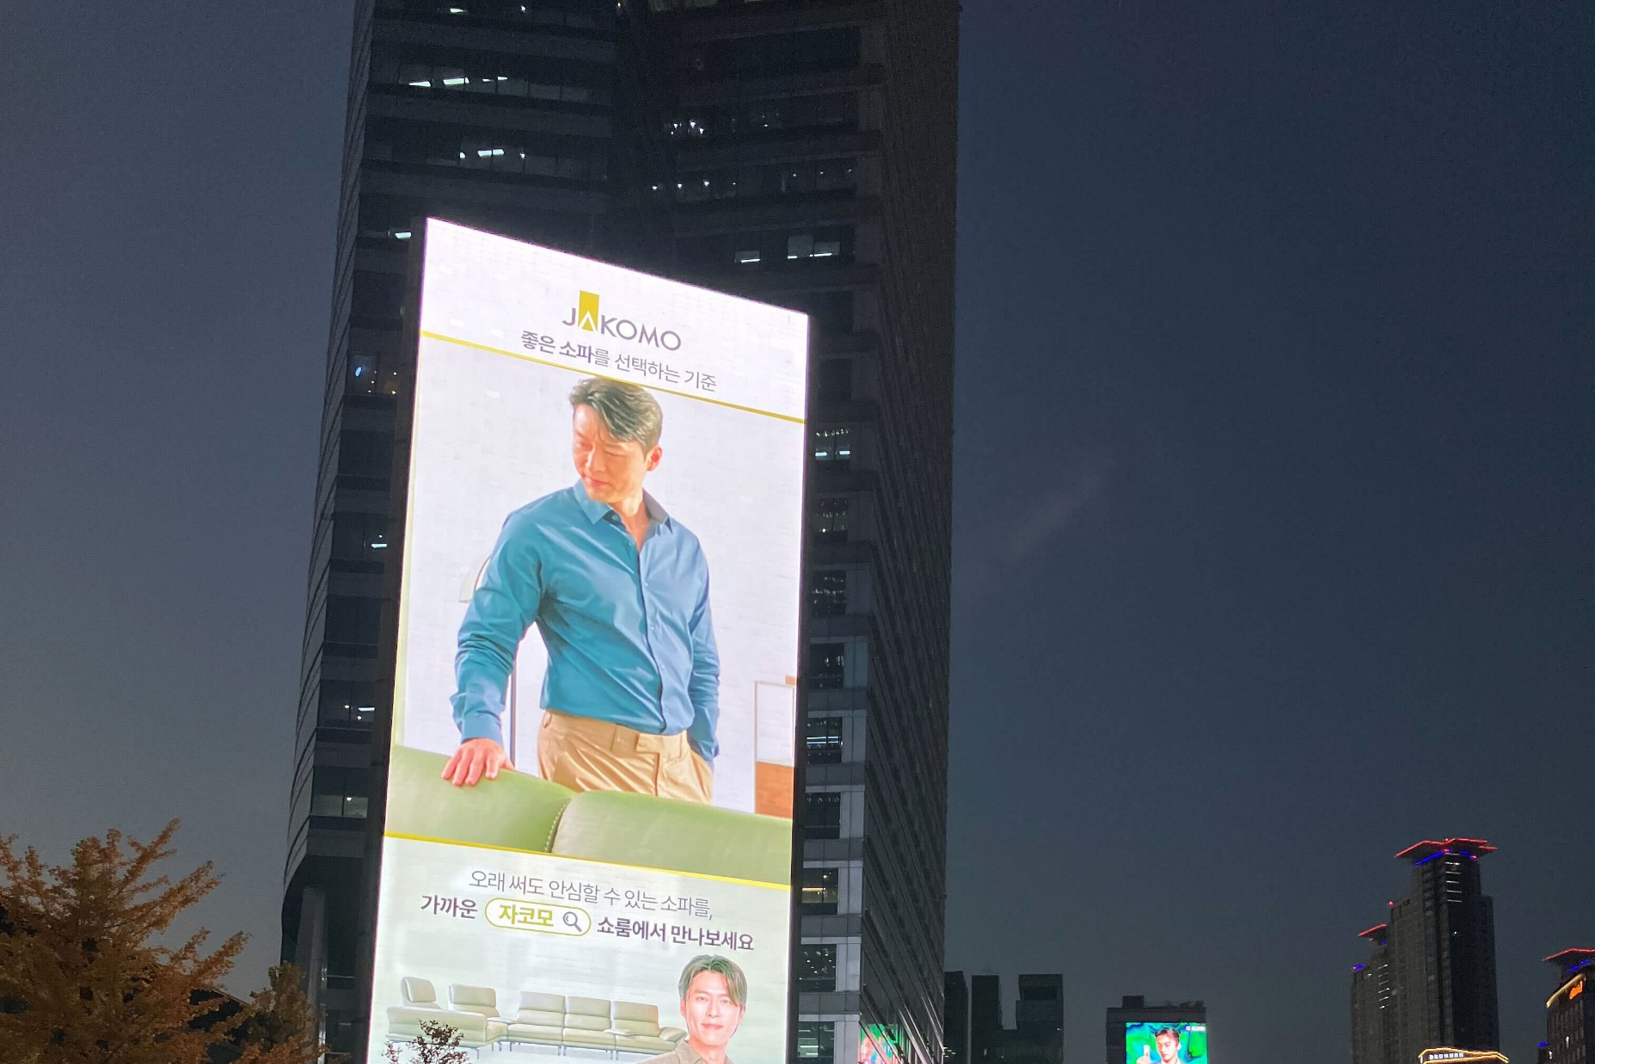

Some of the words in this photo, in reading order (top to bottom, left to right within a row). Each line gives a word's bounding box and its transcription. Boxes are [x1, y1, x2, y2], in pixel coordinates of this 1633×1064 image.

[562, 306, 681, 352] JAKOMO
[521, 331, 556, 355] 좋은
[559, 341, 610, 367] 소파를
[615, 354, 681, 384] 선택하는
[685, 370, 717, 392] 기준
[469, 870, 505, 893] 오래
[509, 874, 545, 896] 써도
[549, 879, 600, 904] 안심할
[604, 887, 621, 907] 수
[624, 889, 658, 911] 있는
[661, 895, 713, 920] 소파를,
[421, 895, 478, 920] 가까운
[498, 904, 555, 928] 자코모
[597, 917, 666, 944] 쇼룸에서
[671, 925, 754, 952] 만나보세요
